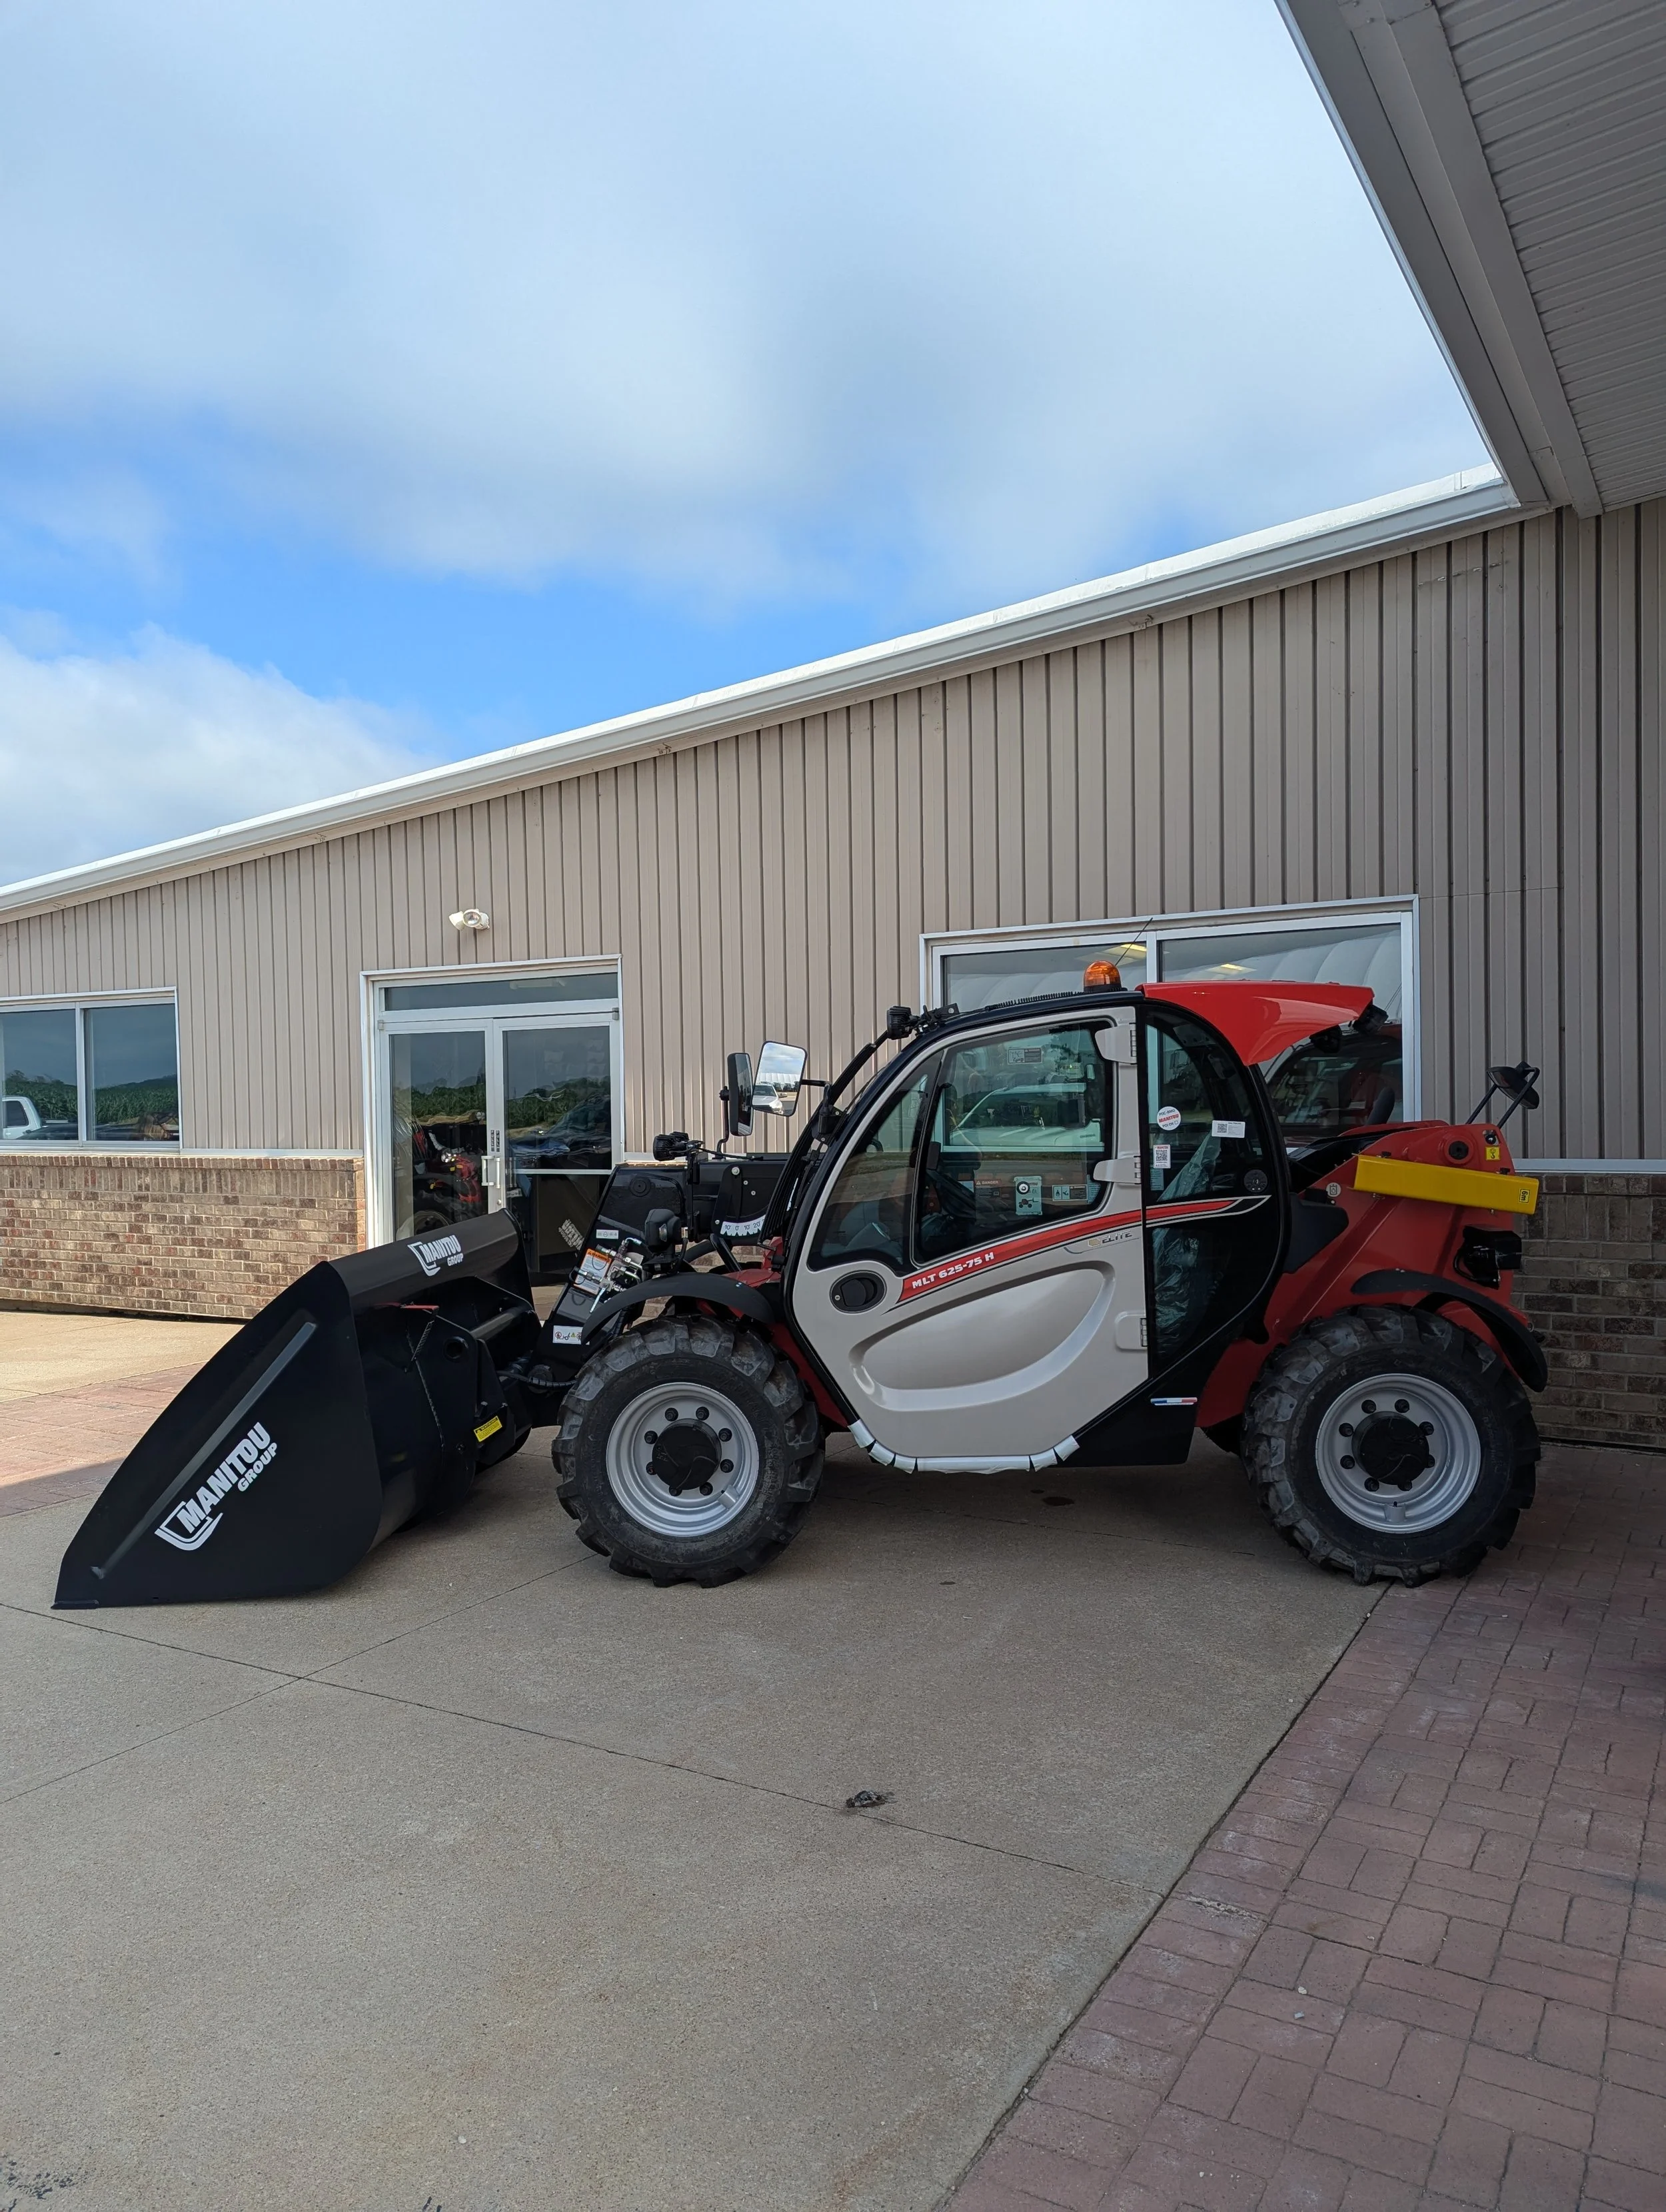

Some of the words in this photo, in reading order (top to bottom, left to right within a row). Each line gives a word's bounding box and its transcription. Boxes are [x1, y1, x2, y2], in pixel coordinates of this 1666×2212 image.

[1158, 1113, 1179, 1123] MANITOU
[1521, 1191, 1527, 1201] 6m
[1102, 1230, 1133, 1243] ELITE
[418, 1235, 461, 1263] MANITOU
[447, 1253, 463, 1266] GROUP
[912, 1274, 936, 1289] MLT
[938, 1257, 982, 1278] 625-75
[985, 1252, 994, 1261] H
[238, 1442, 277, 1492] GROUP
[177, 1422, 271, 1534] MANITOU
